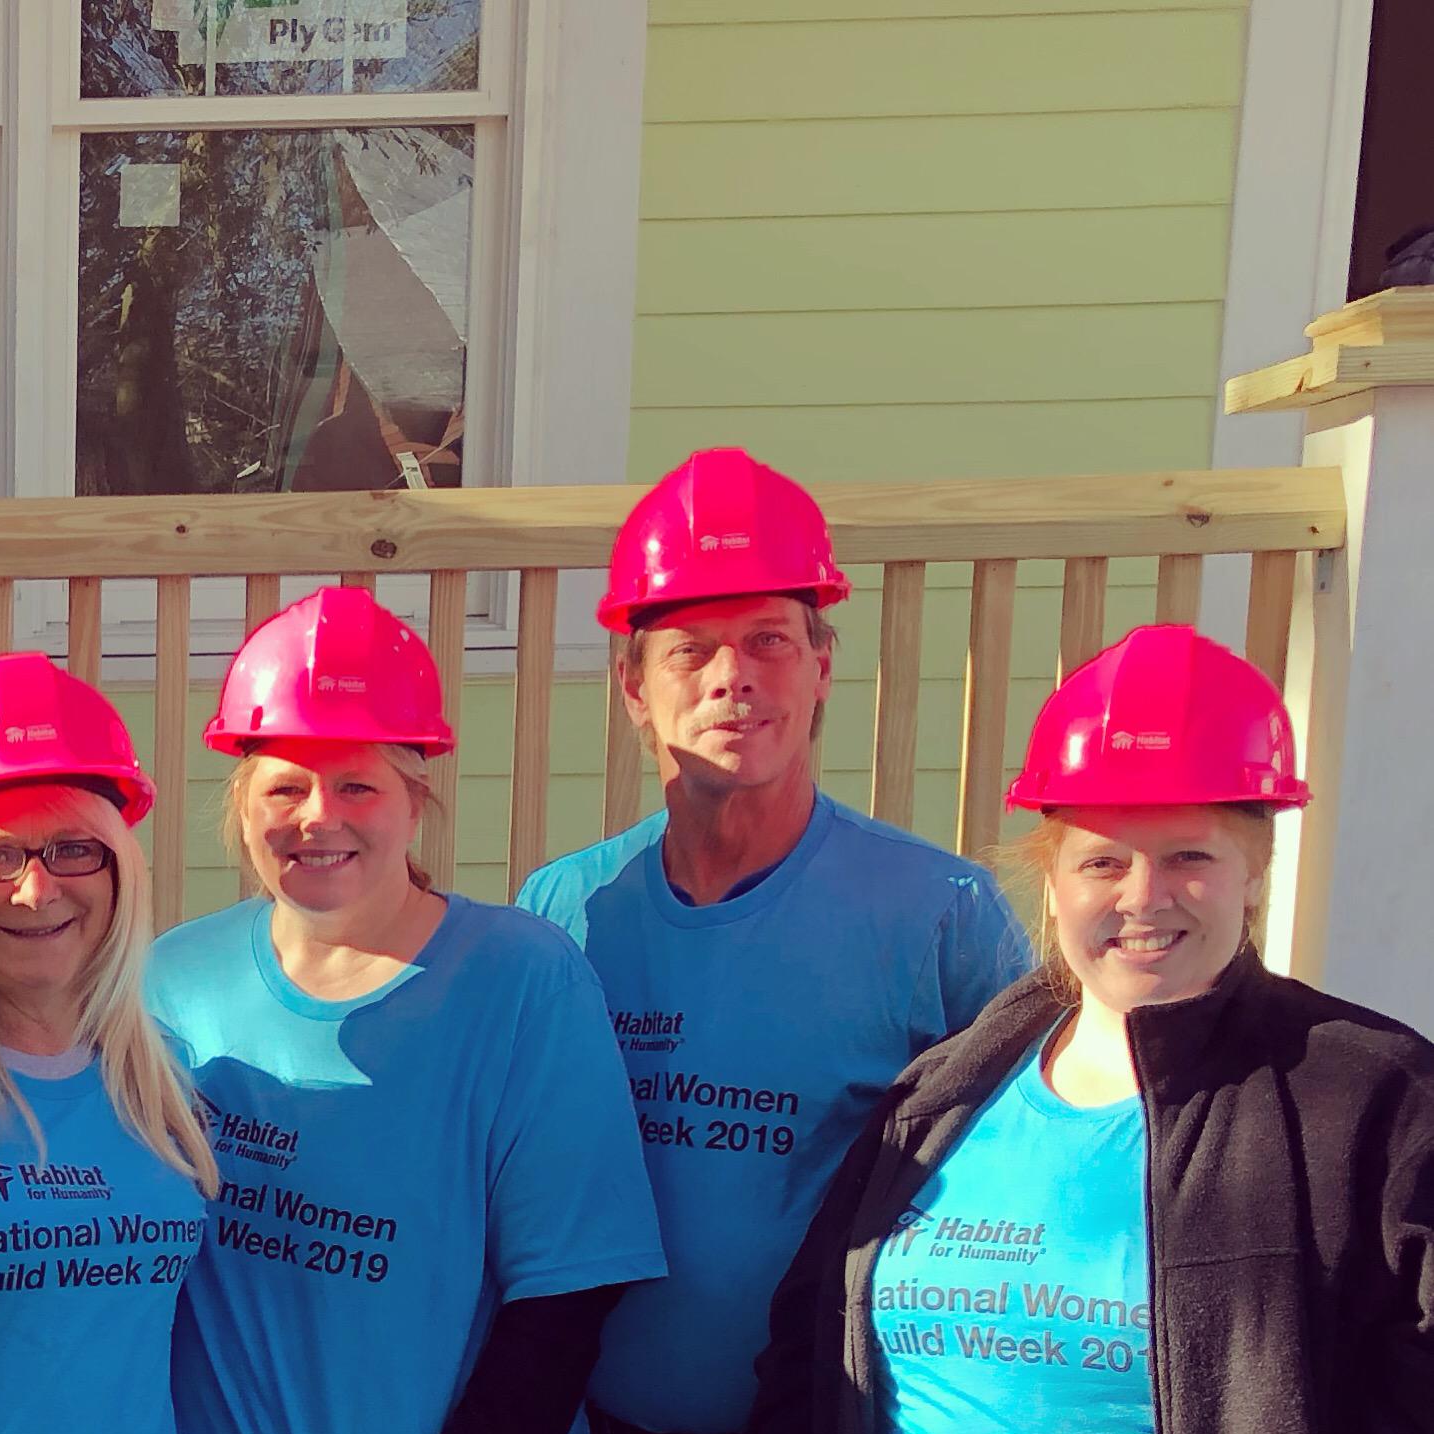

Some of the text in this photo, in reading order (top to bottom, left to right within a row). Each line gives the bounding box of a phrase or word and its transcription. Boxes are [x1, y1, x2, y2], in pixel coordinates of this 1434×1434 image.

[269, 18, 316, 52] Ply
[614, 1009, 685, 1035] Habitat
[665, 1072, 799, 1115] Women
[214, 1138, 233, 1153] for
[221, 1112, 299, 1153] Habitat
[705, 1120, 794, 1156] 2019
[18, 1163, 107, 1187] Habitat
[26, 1187, 47, 1200] for
[274, 1187, 397, 1242] Women
[935, 1217, 1045, 1245] Habitat
[217, 1216, 390, 1284] Week 2019
[929, 1243, 953, 1258] for
[57, 1256, 143, 1287] Week
[871, 1277, 1010, 1315] ational
[956, 1325, 1069, 1366] Week
